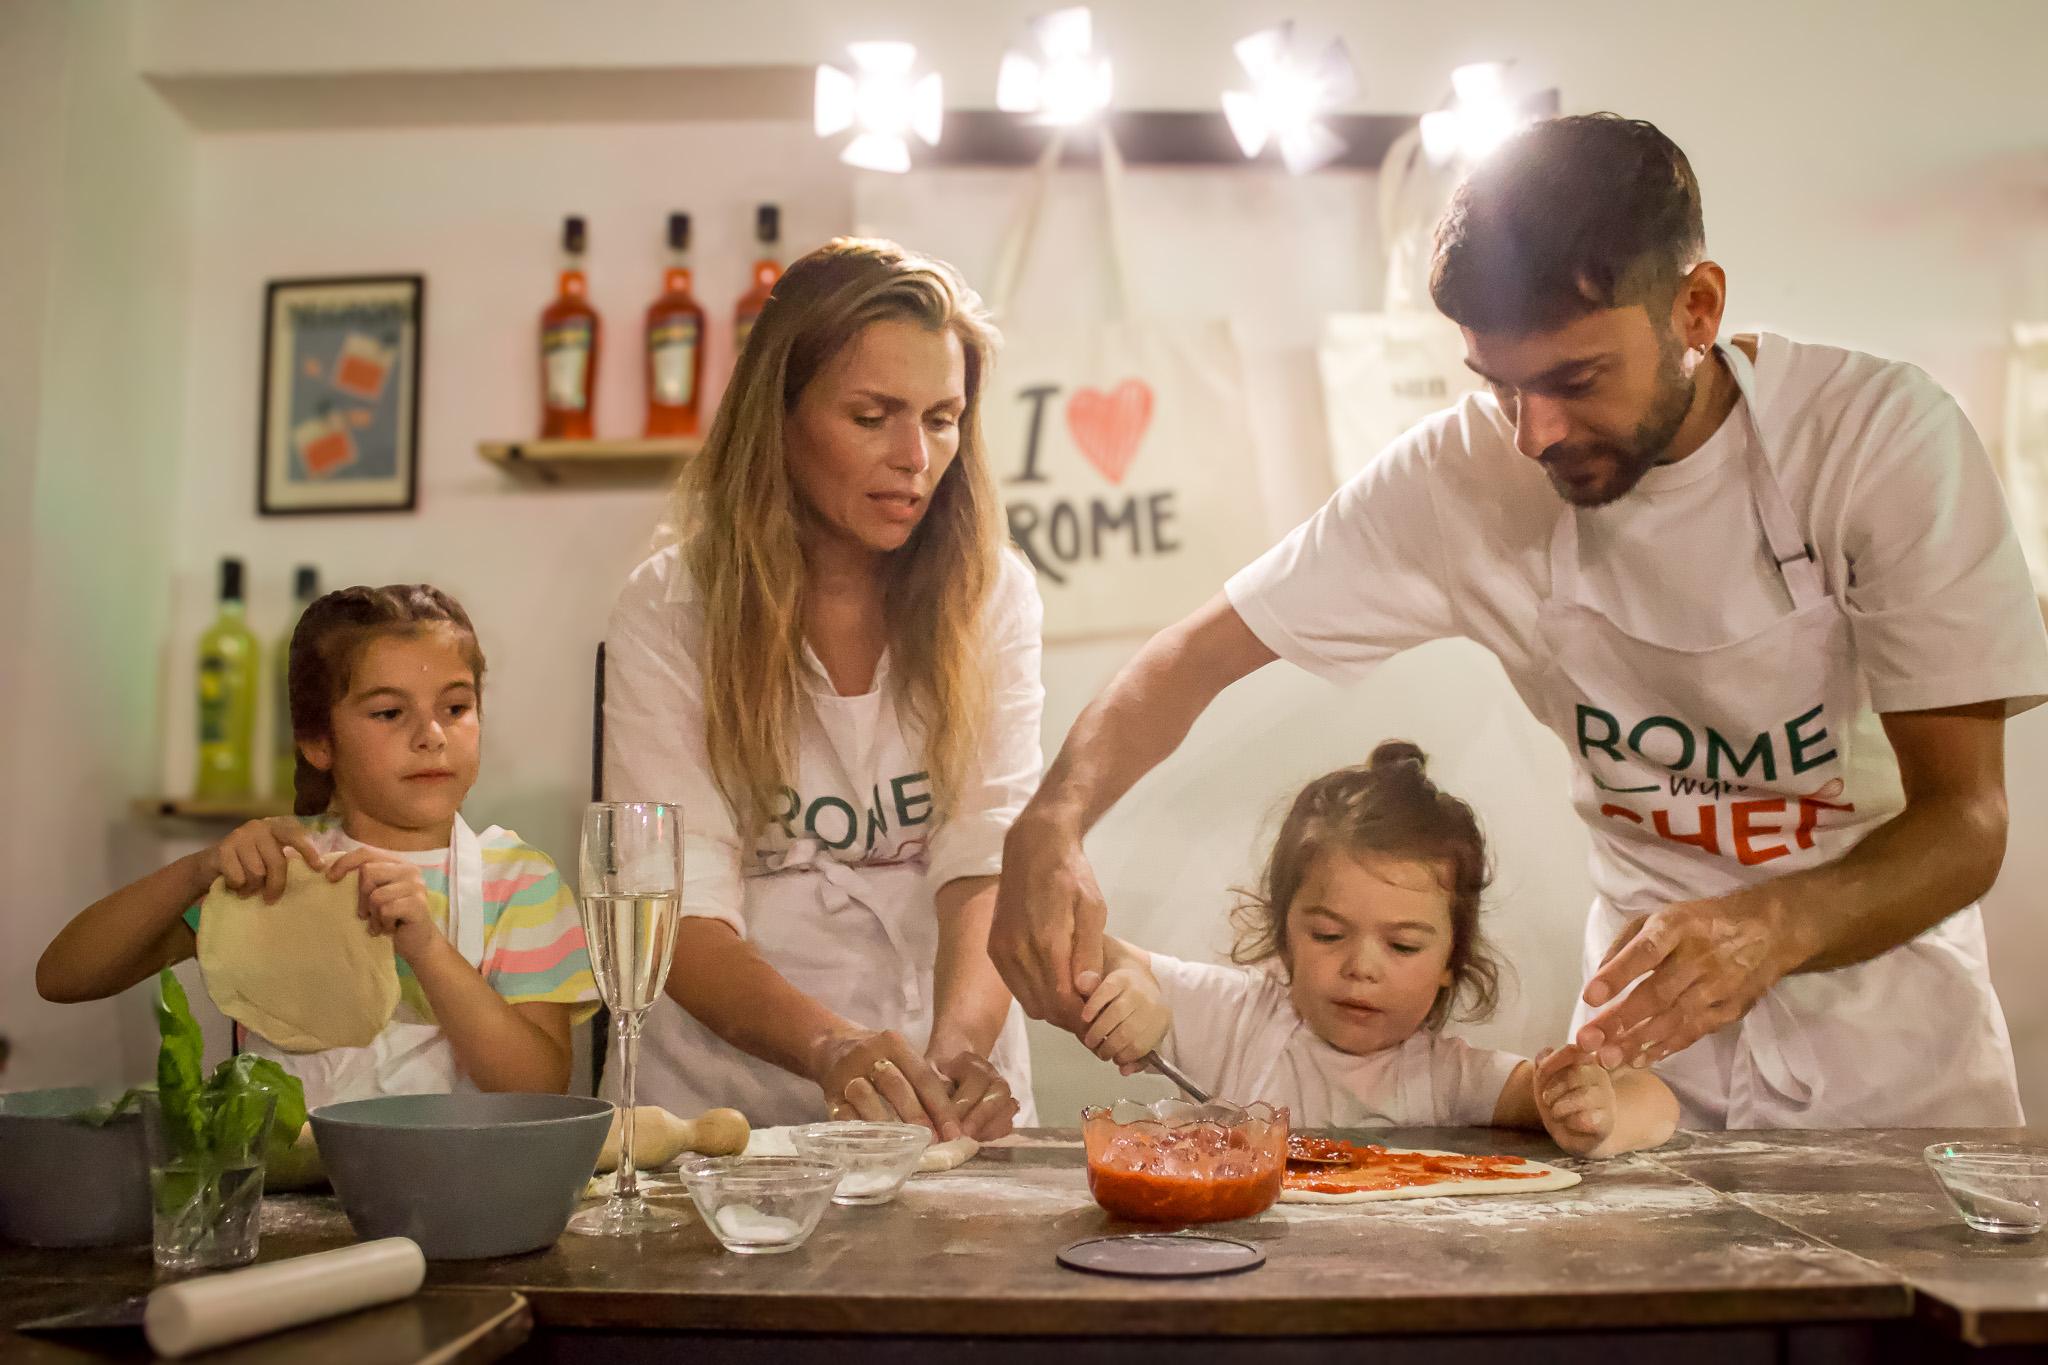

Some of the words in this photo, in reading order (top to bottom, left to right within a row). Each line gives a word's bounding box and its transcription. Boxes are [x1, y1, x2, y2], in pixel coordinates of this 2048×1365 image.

[1003, 380, 1062, 485] I
[1005, 490, 1182, 585] ROME
[1576, 703, 1838, 781] ROME
